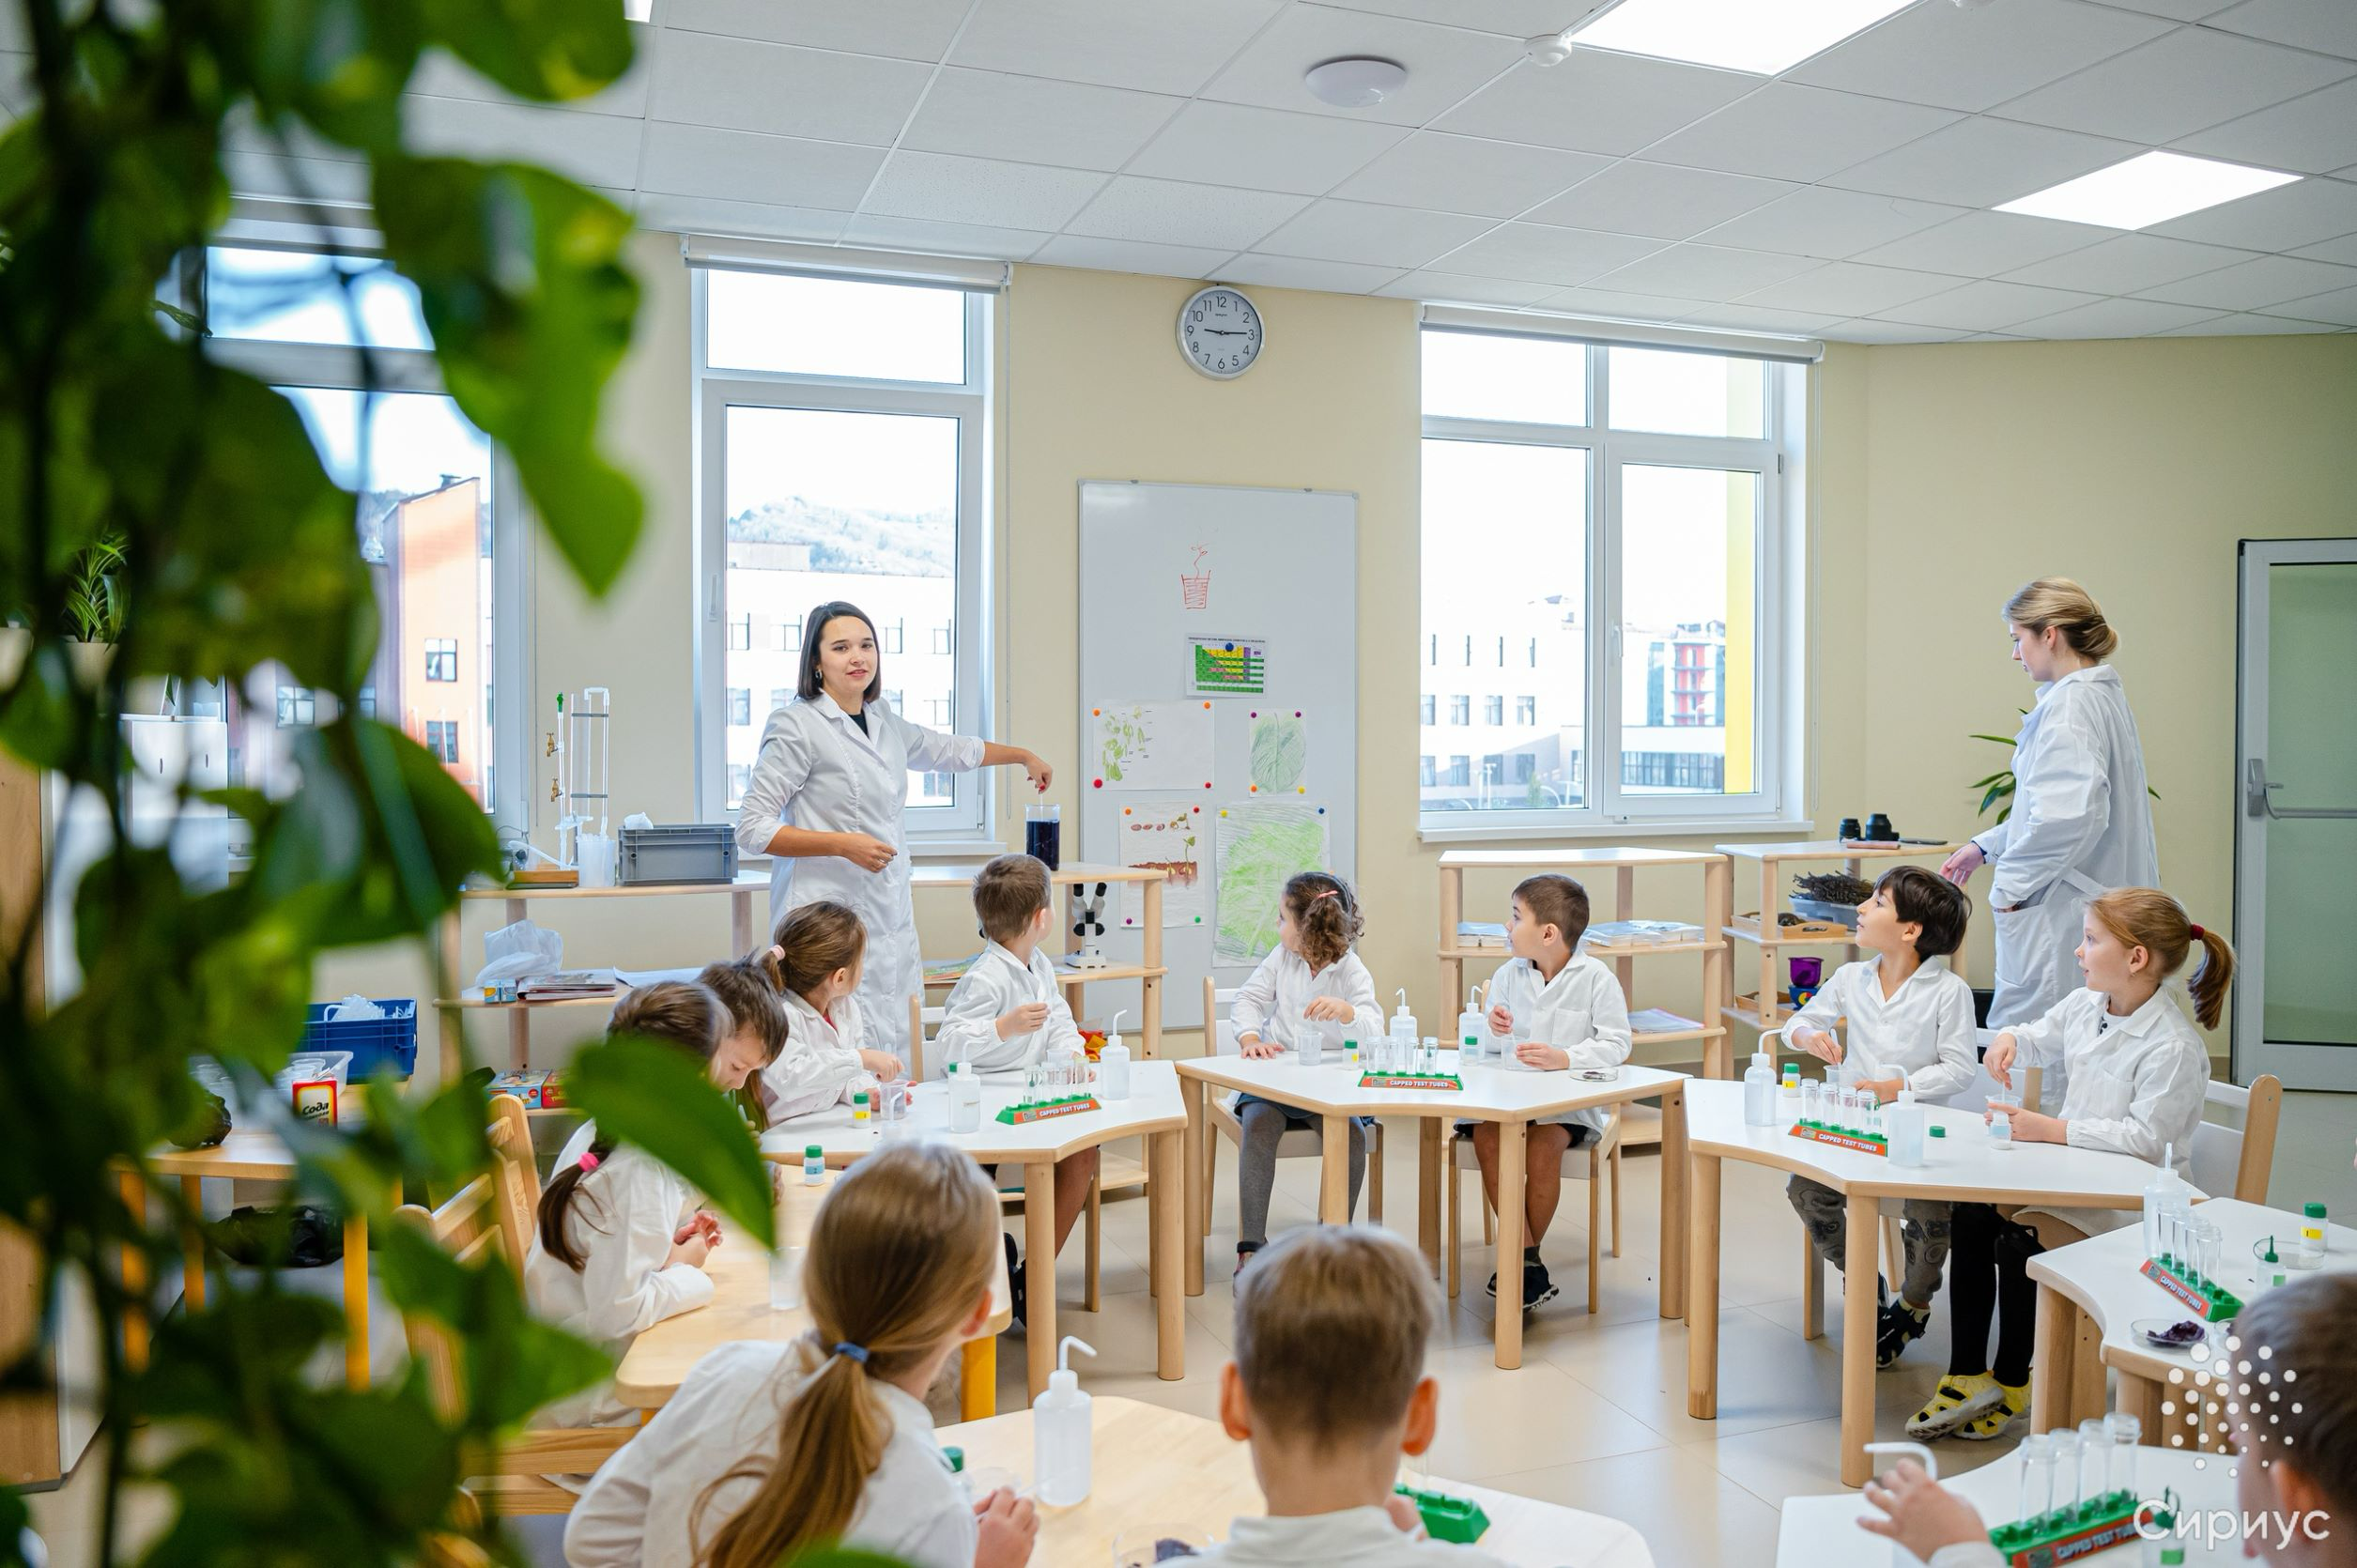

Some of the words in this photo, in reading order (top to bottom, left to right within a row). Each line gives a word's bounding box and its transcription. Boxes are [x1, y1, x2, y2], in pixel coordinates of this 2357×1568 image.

[1203, 300, 1212, 312] 11
[1216, 296, 1226, 308] 12
[1192, 310, 1204, 322] 10
[1242, 312, 1250, 324] 2
[1186, 325, 1194, 336] 9
[1247, 329, 1255, 341] 3
[1192, 341, 1199, 353] 8
[1242, 345, 1250, 356] 4
[1204, 353, 1210, 364] 7
[1217, 358, 1225, 369] 6
[1231, 355, 1240, 366] 5
[302, 1101, 329, 1115] Сода
[1040, 1108, 1059, 1116] CAPPED
[1818, 1133, 1841, 1144] CAPPED
[1842, 1138, 1857, 1147] TEST
[1857, 1142, 1878, 1152] TUBES
[2160, 1275, 2178, 1292] CAPPED
[2178, 1286, 2189, 1299] TEST
[2056, 1539, 2092, 1559] CAPPED
[2092, 1530, 2115, 1545] TEST
